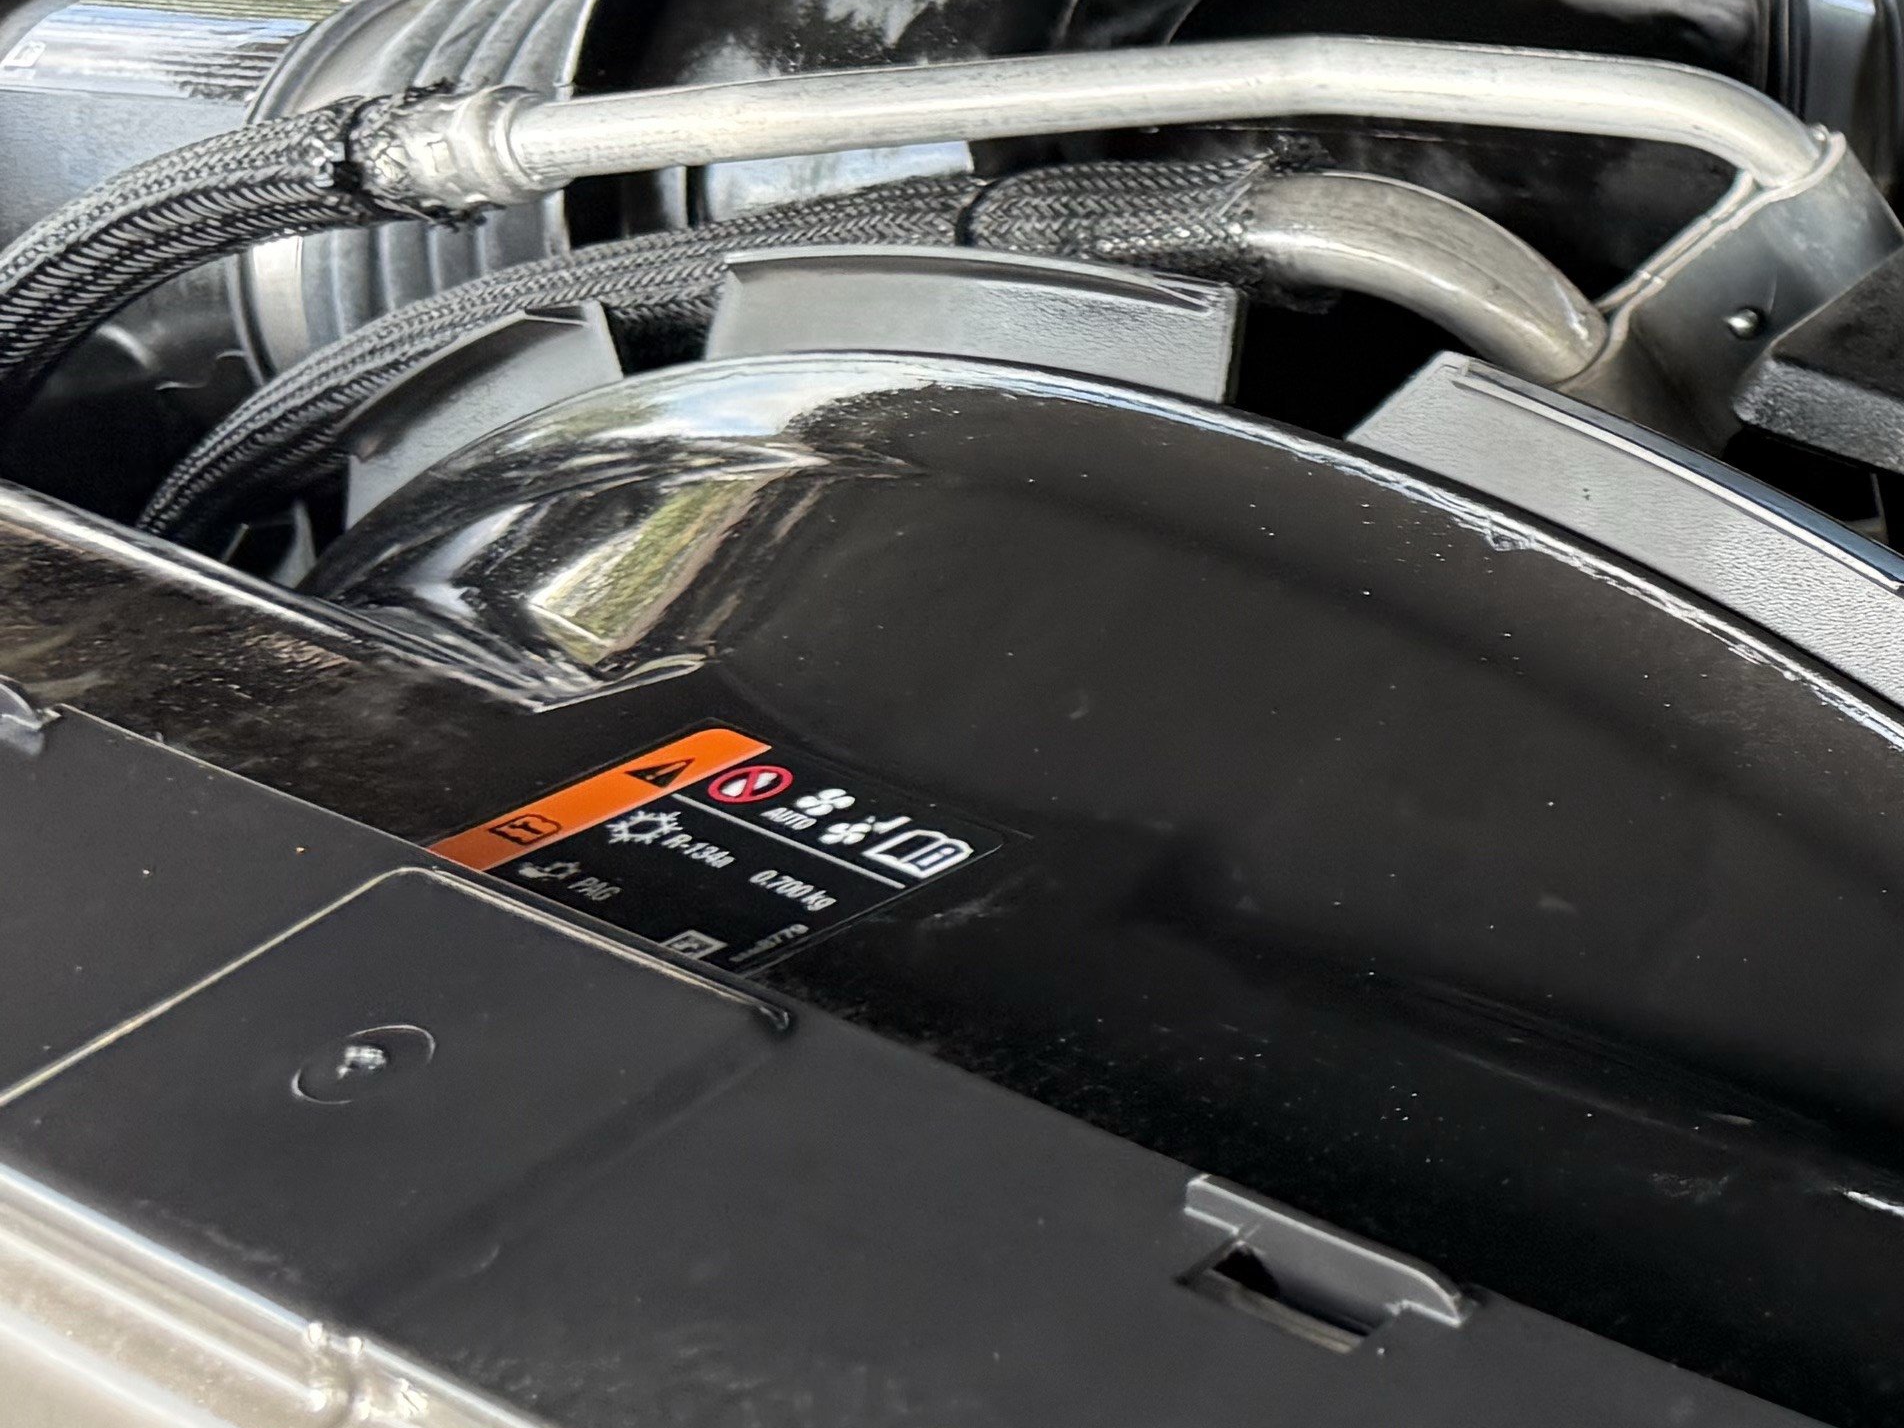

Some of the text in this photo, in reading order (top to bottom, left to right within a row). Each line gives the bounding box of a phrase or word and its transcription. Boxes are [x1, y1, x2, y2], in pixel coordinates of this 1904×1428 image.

[759, 806, 818, 831] AUTO
[660, 833, 838, 912] R-134a 0.700 kg
[566, 876, 622, 902] PAG
